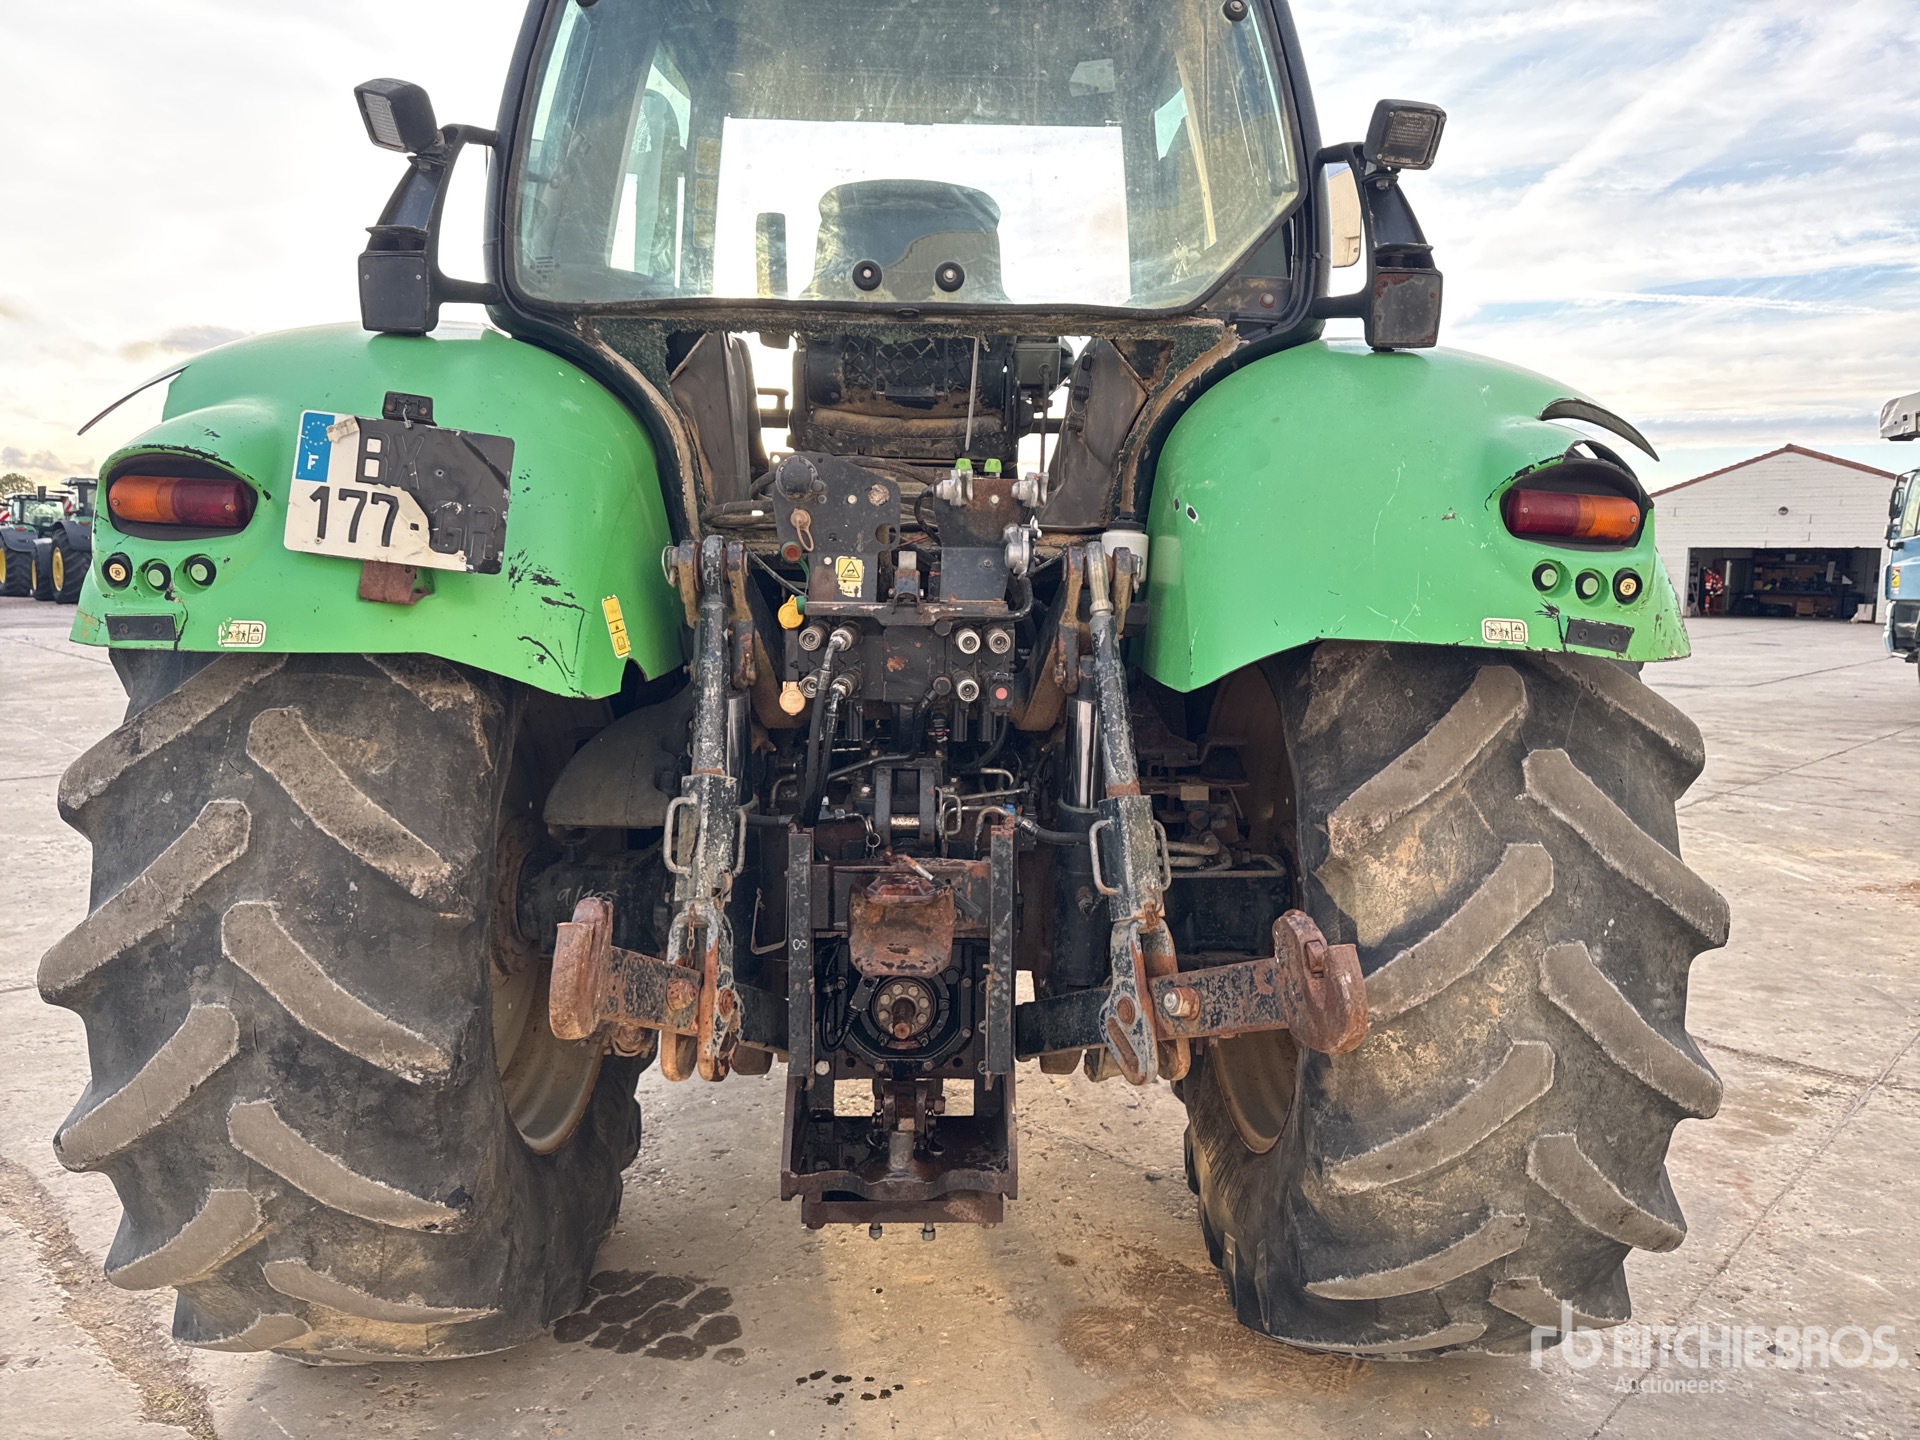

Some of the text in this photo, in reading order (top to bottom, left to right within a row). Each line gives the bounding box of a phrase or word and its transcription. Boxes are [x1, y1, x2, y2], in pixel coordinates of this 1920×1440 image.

[307, 454, 319, 470] F
[356, 431, 425, 490] BX
[309, 485, 400, 548] 177
